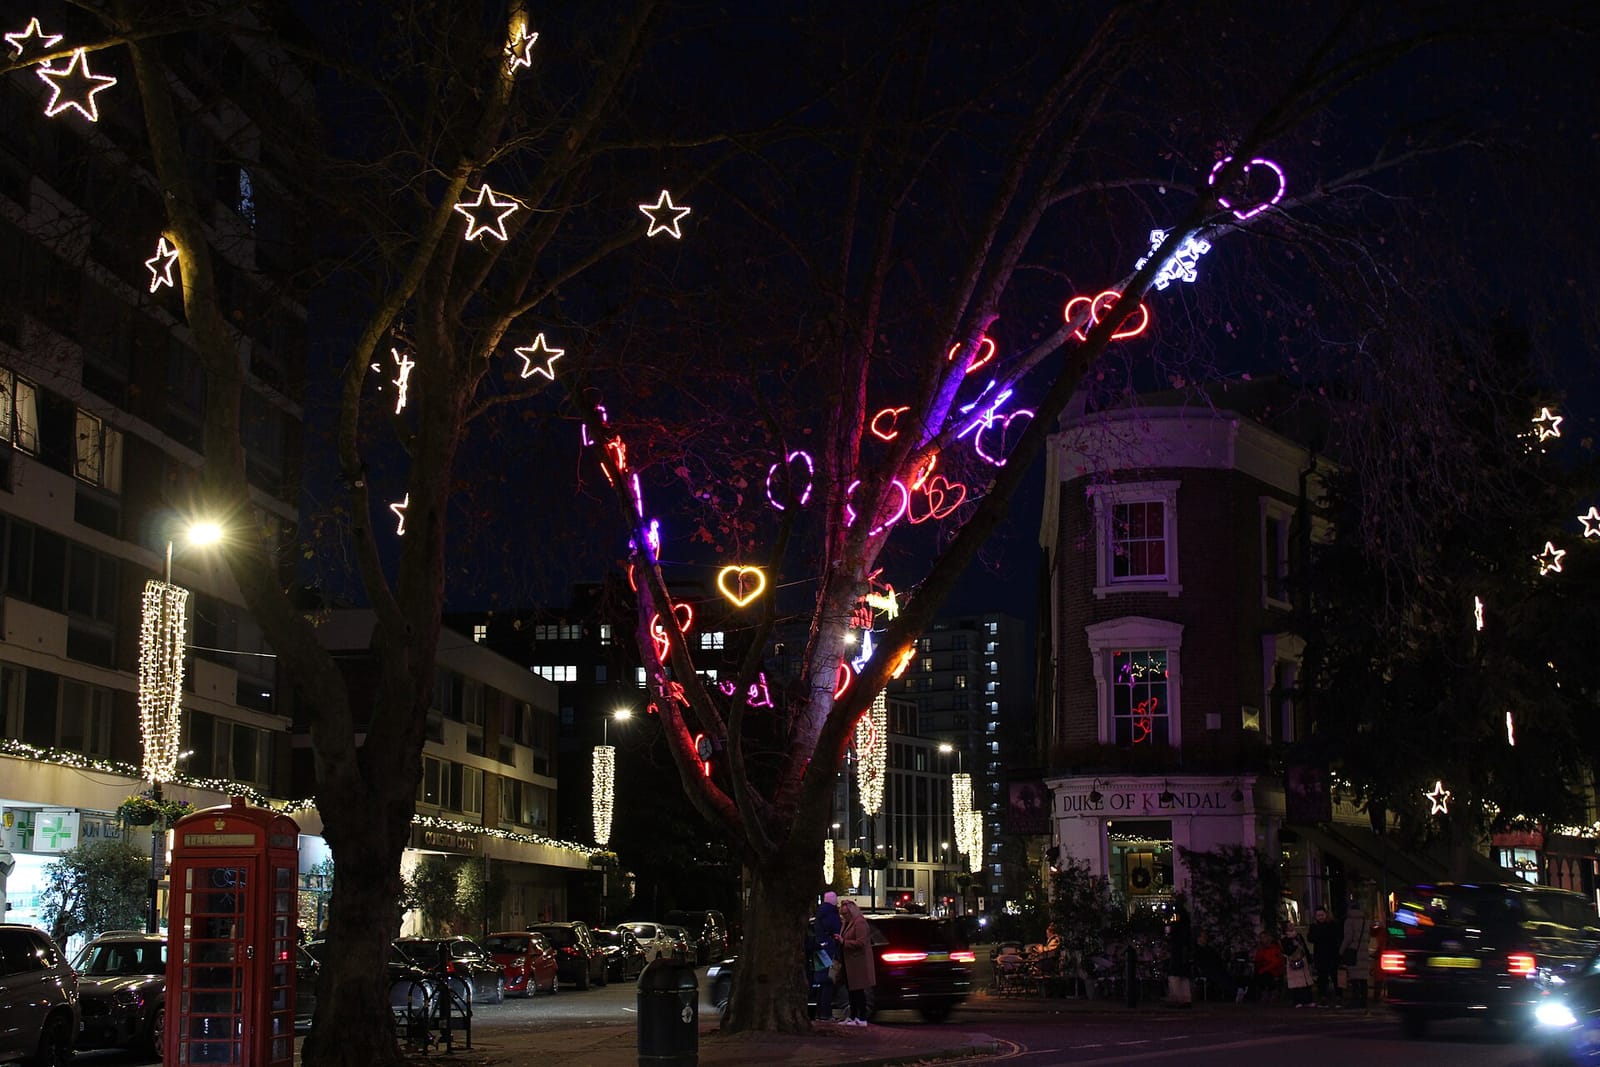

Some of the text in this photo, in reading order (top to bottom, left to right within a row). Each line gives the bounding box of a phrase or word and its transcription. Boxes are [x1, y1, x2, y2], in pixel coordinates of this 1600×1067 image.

[1063, 792, 1226, 811] DUKE OF KENDAL
